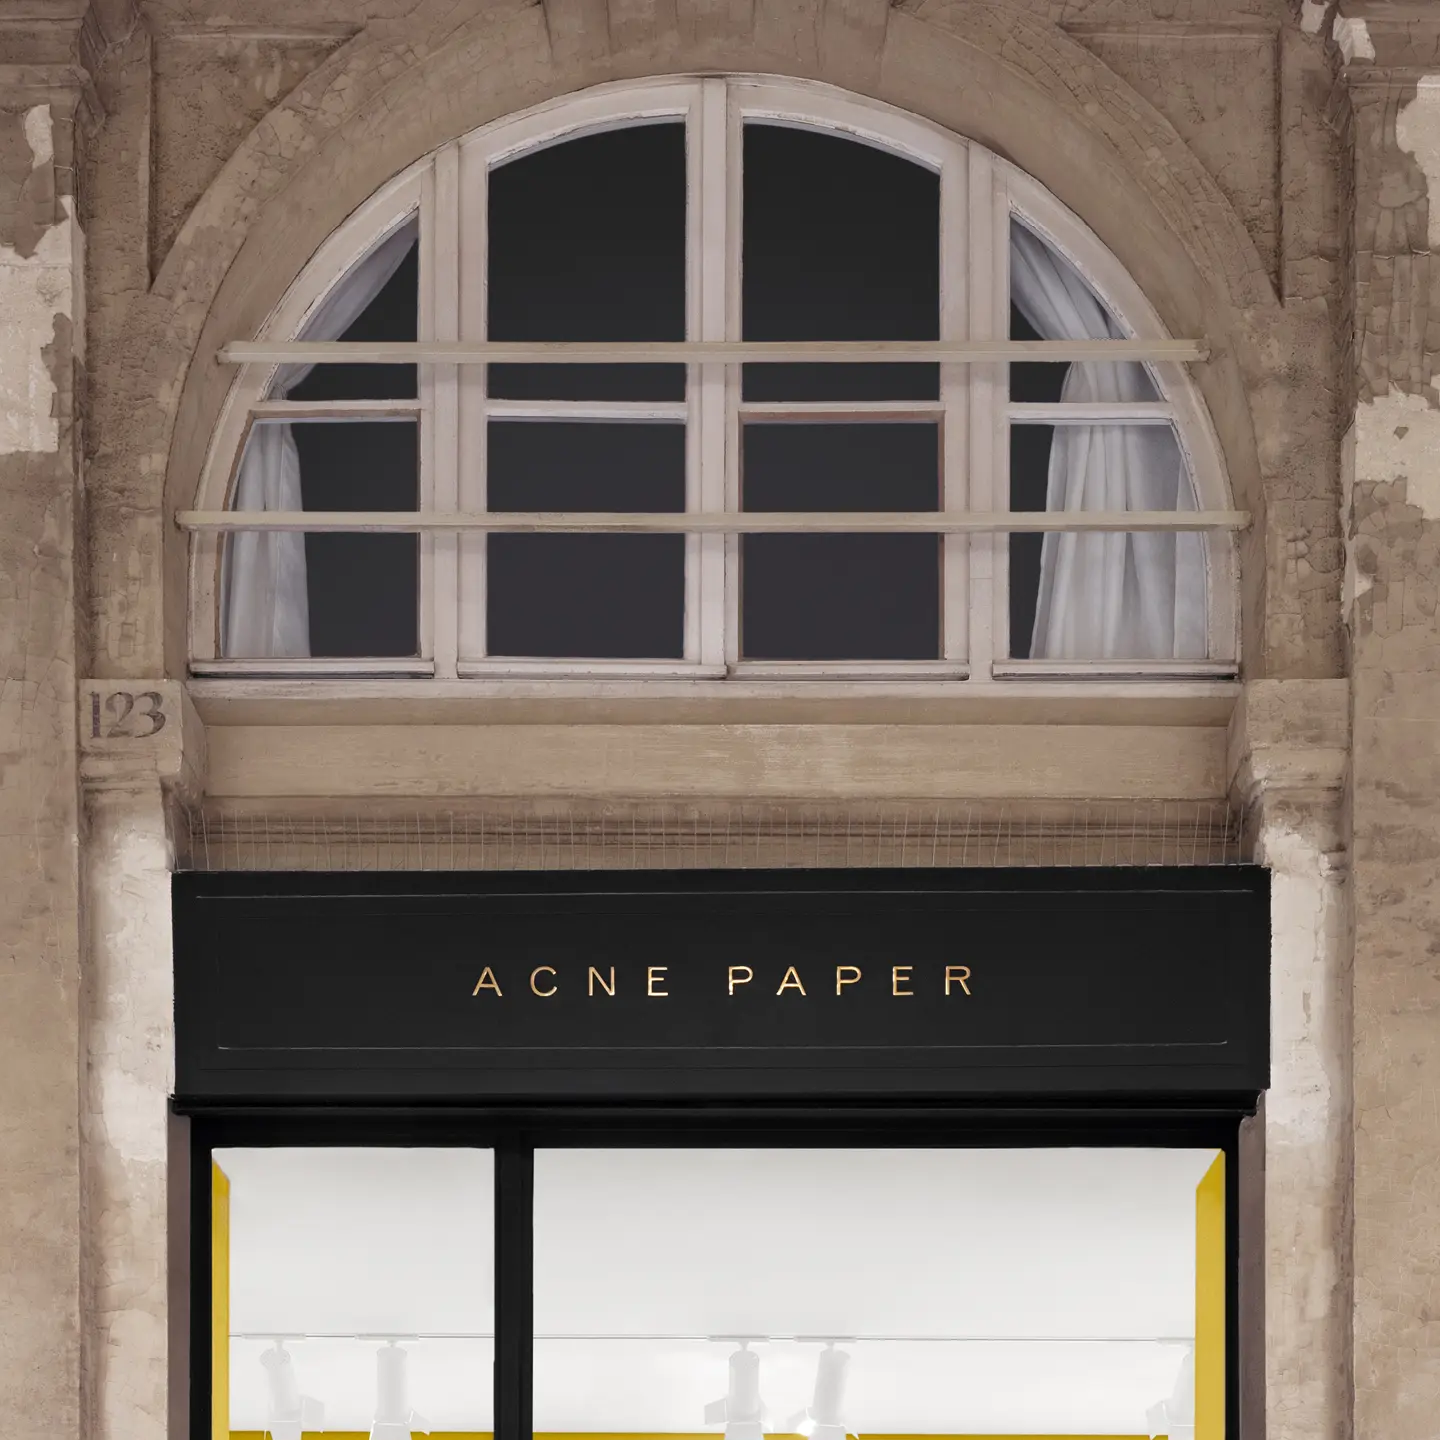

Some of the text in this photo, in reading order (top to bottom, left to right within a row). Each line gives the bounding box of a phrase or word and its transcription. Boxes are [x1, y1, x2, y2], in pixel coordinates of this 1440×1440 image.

[89, 691, 166, 739] 123
[471, 965, 972, 997] ACNE PAPER
